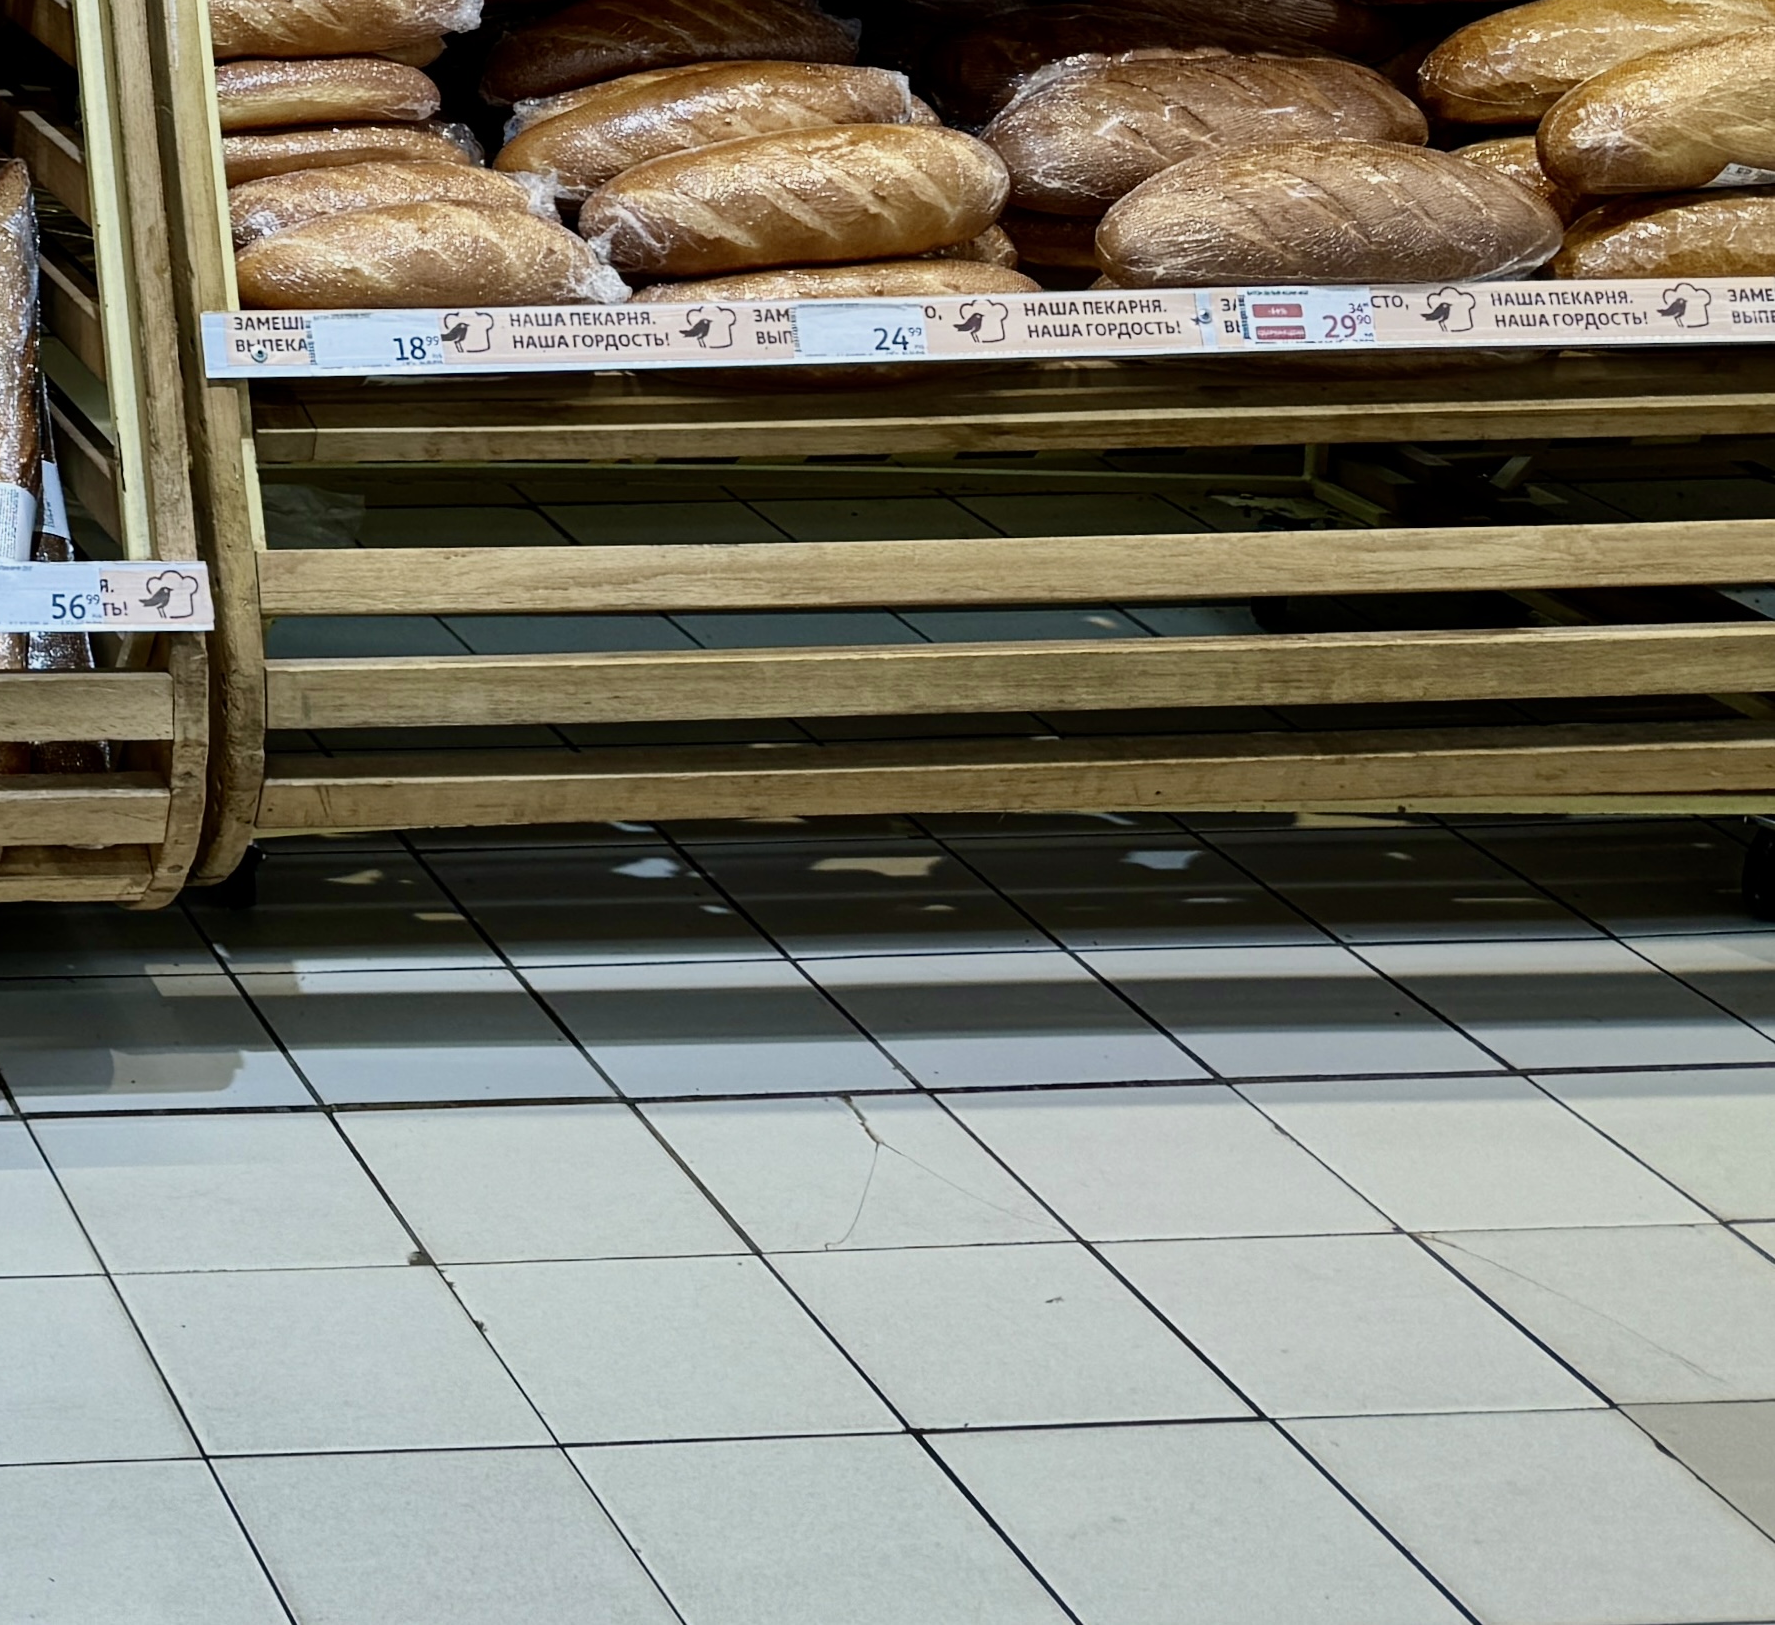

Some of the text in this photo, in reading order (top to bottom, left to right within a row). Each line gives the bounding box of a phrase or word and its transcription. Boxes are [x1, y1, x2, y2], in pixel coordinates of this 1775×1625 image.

[1491, 291, 1633, 306] НАША ПЕКАРНЯ.
[1024, 300, 1167, 316] НАША ПЕКАРНЯ.
[510, 312, 656, 327] НАША ПЕКАРНЯ.
[1495, 311, 1647, 330] НАША ГОРДОСТЬ!
[1028, 321, 1181, 339] НАША ГОРДОСТЬ!
[513, 333, 668, 351] НАША ГОРДОСТЬ!
